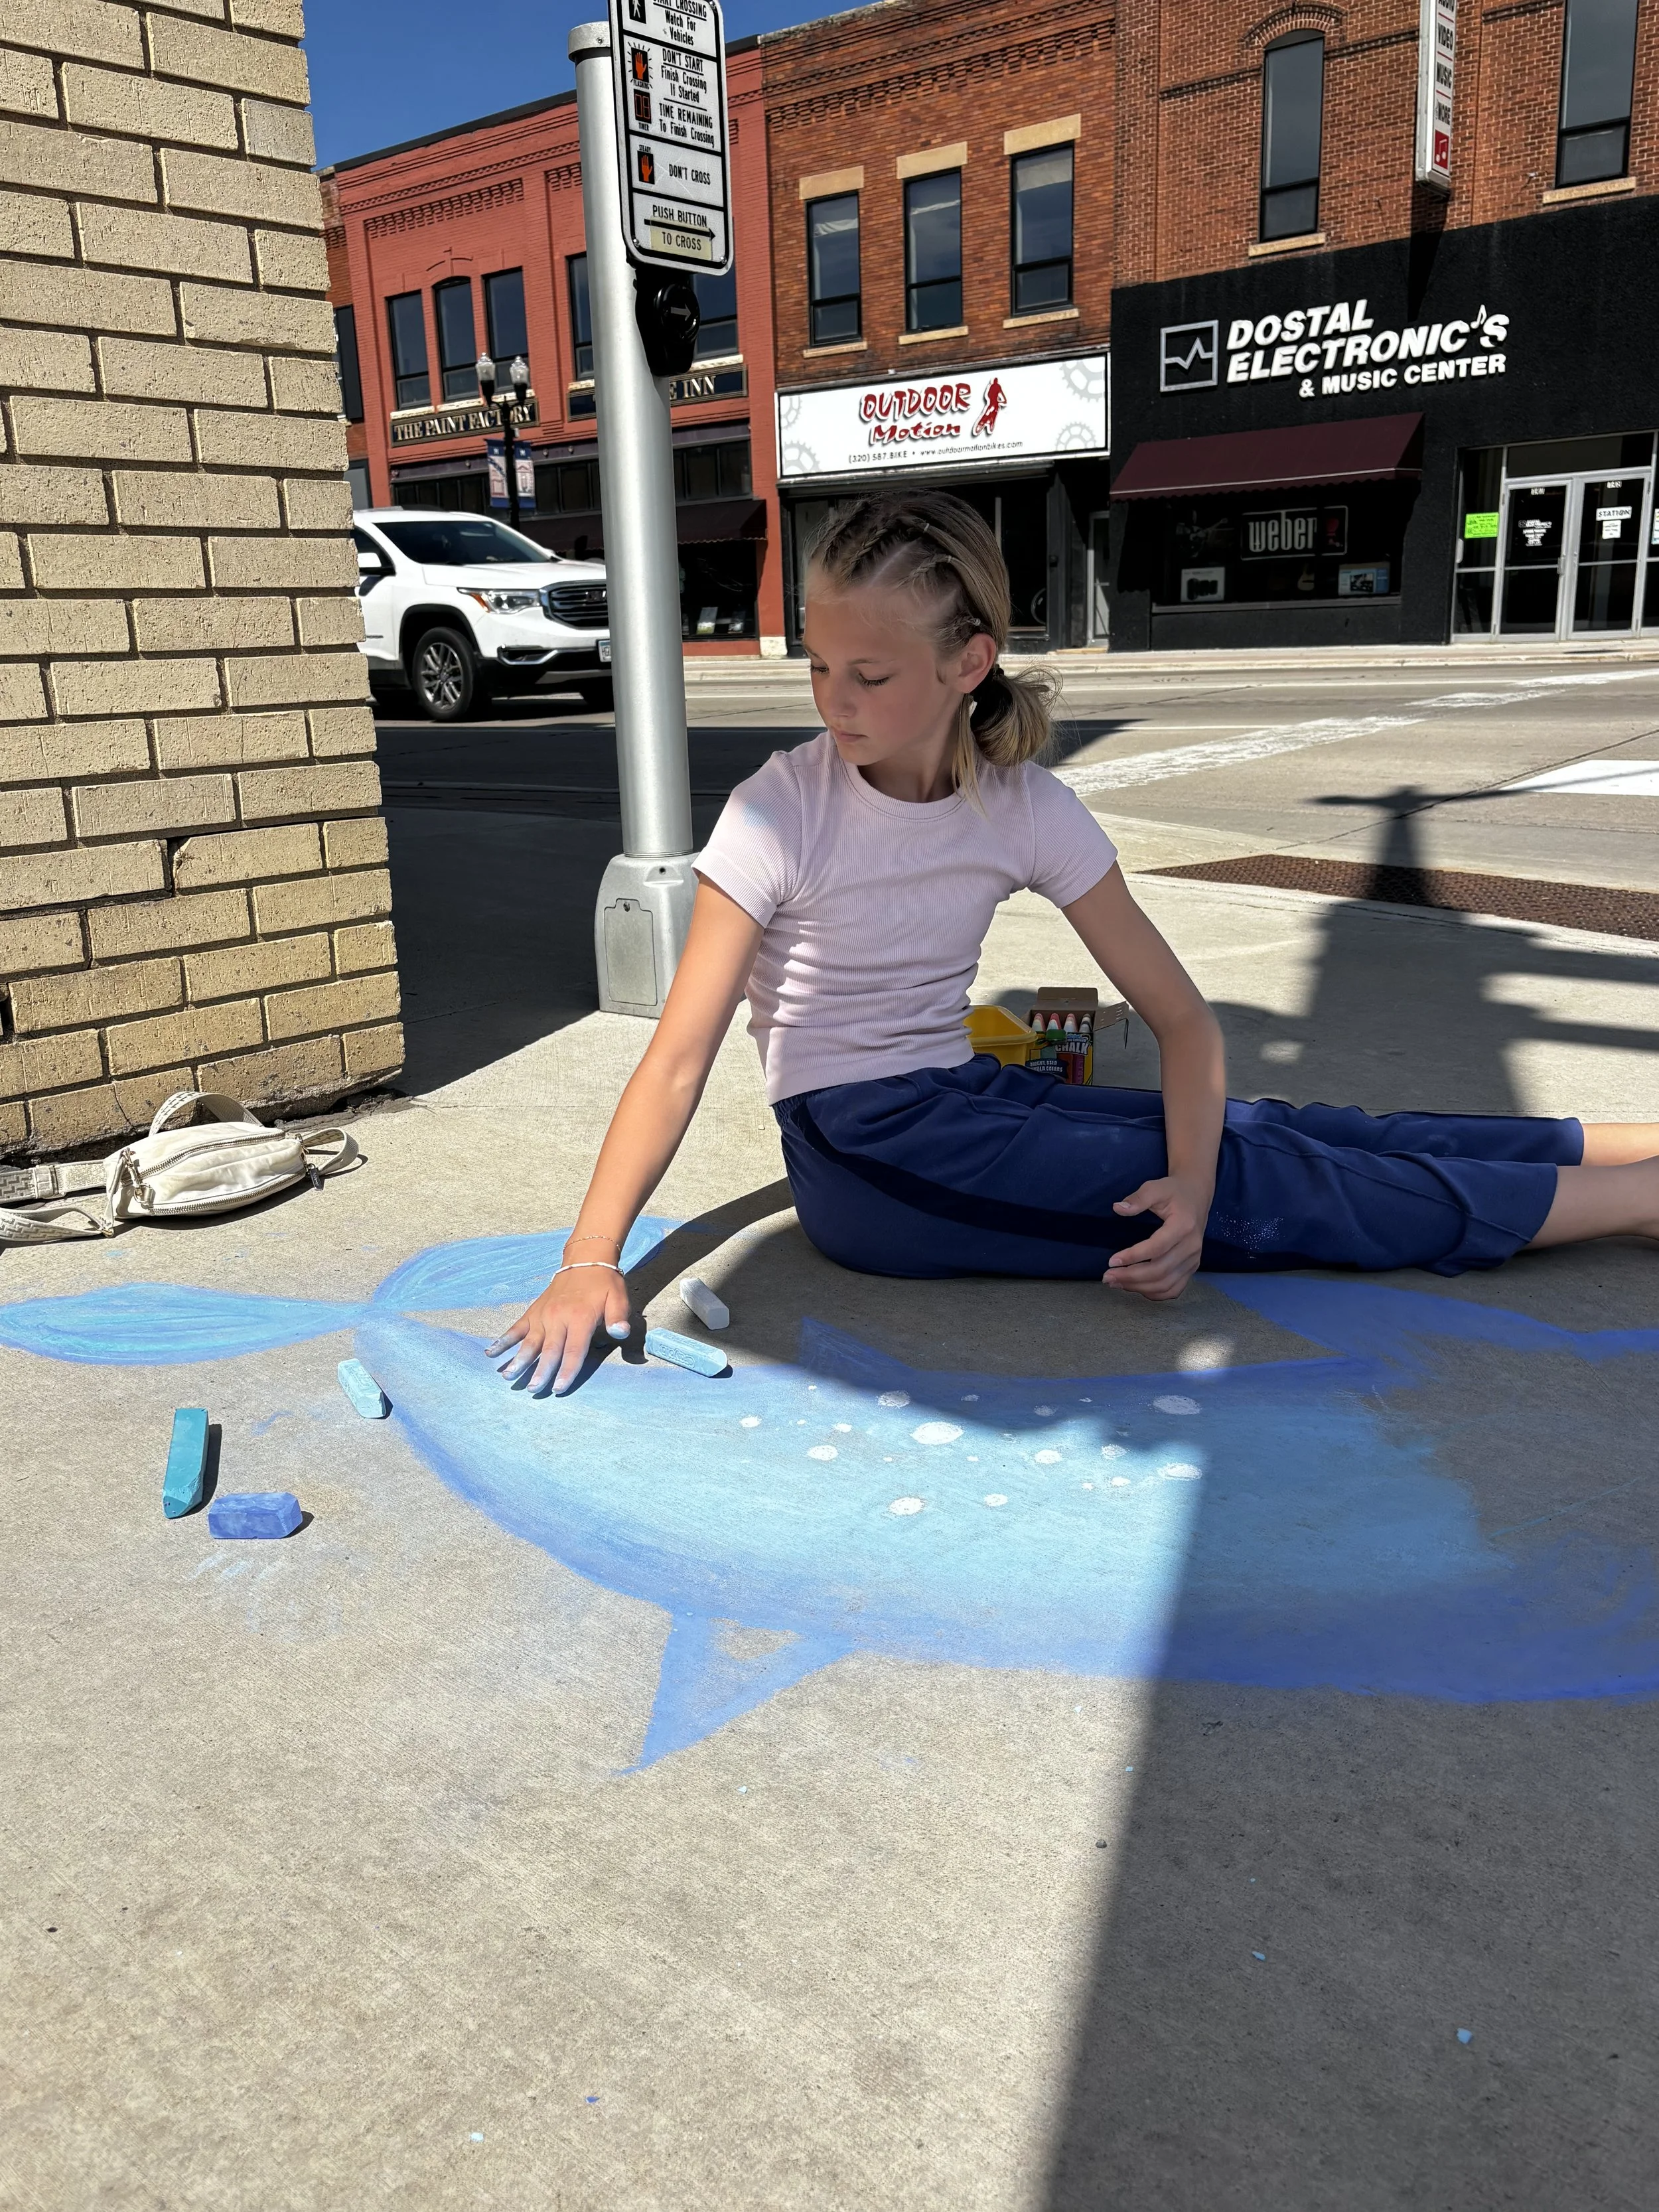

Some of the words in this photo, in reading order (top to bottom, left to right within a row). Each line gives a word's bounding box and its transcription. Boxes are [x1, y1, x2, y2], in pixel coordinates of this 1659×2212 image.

[665, 9, 684, 28] Watch
[687, 17, 696, 32] For
[669, 26, 694, 46] Vehicles
[662, 48, 681, 66] DON'T
[684, 55, 703, 72] START
[661, 65, 679, 83] Finish
[682, 71, 707, 94] Crossing
[670, 82, 676, 97] If
[678, 85, 699, 104] Started
[658, 102, 675, 119] TIME
[677, 108, 713, 129] REMAINING
[658, 118, 667, 133] To
[670, 121, 687, 141] Finish
[690, 126, 715, 149] Crossing
[668, 163, 687, 181] DON'T
[691, 169, 711, 186] CROSS
[652, 204, 675, 222] PUSH
[677, 210, 708, 228] BUTTON
[662, 231, 672, 246] TO
[675, 234, 702, 251] CROSS
[1226, 299, 1374, 350] DOSTAL
[682, 374, 717, 399] INN
[1299, 378, 1316, 398] &
[1321, 368, 1398, 396] MUSIC
[1404, 353, 1506, 385] CENTER
[861, 382, 972, 423] OUTDOOR
[394, 421, 423, 441] THE
[425, 413, 467, 437] PAINT
[870, 421, 962, 445] Motion
[1248, 511, 1318, 553] weber
[1055, 1041, 1090, 1055] CHALK
